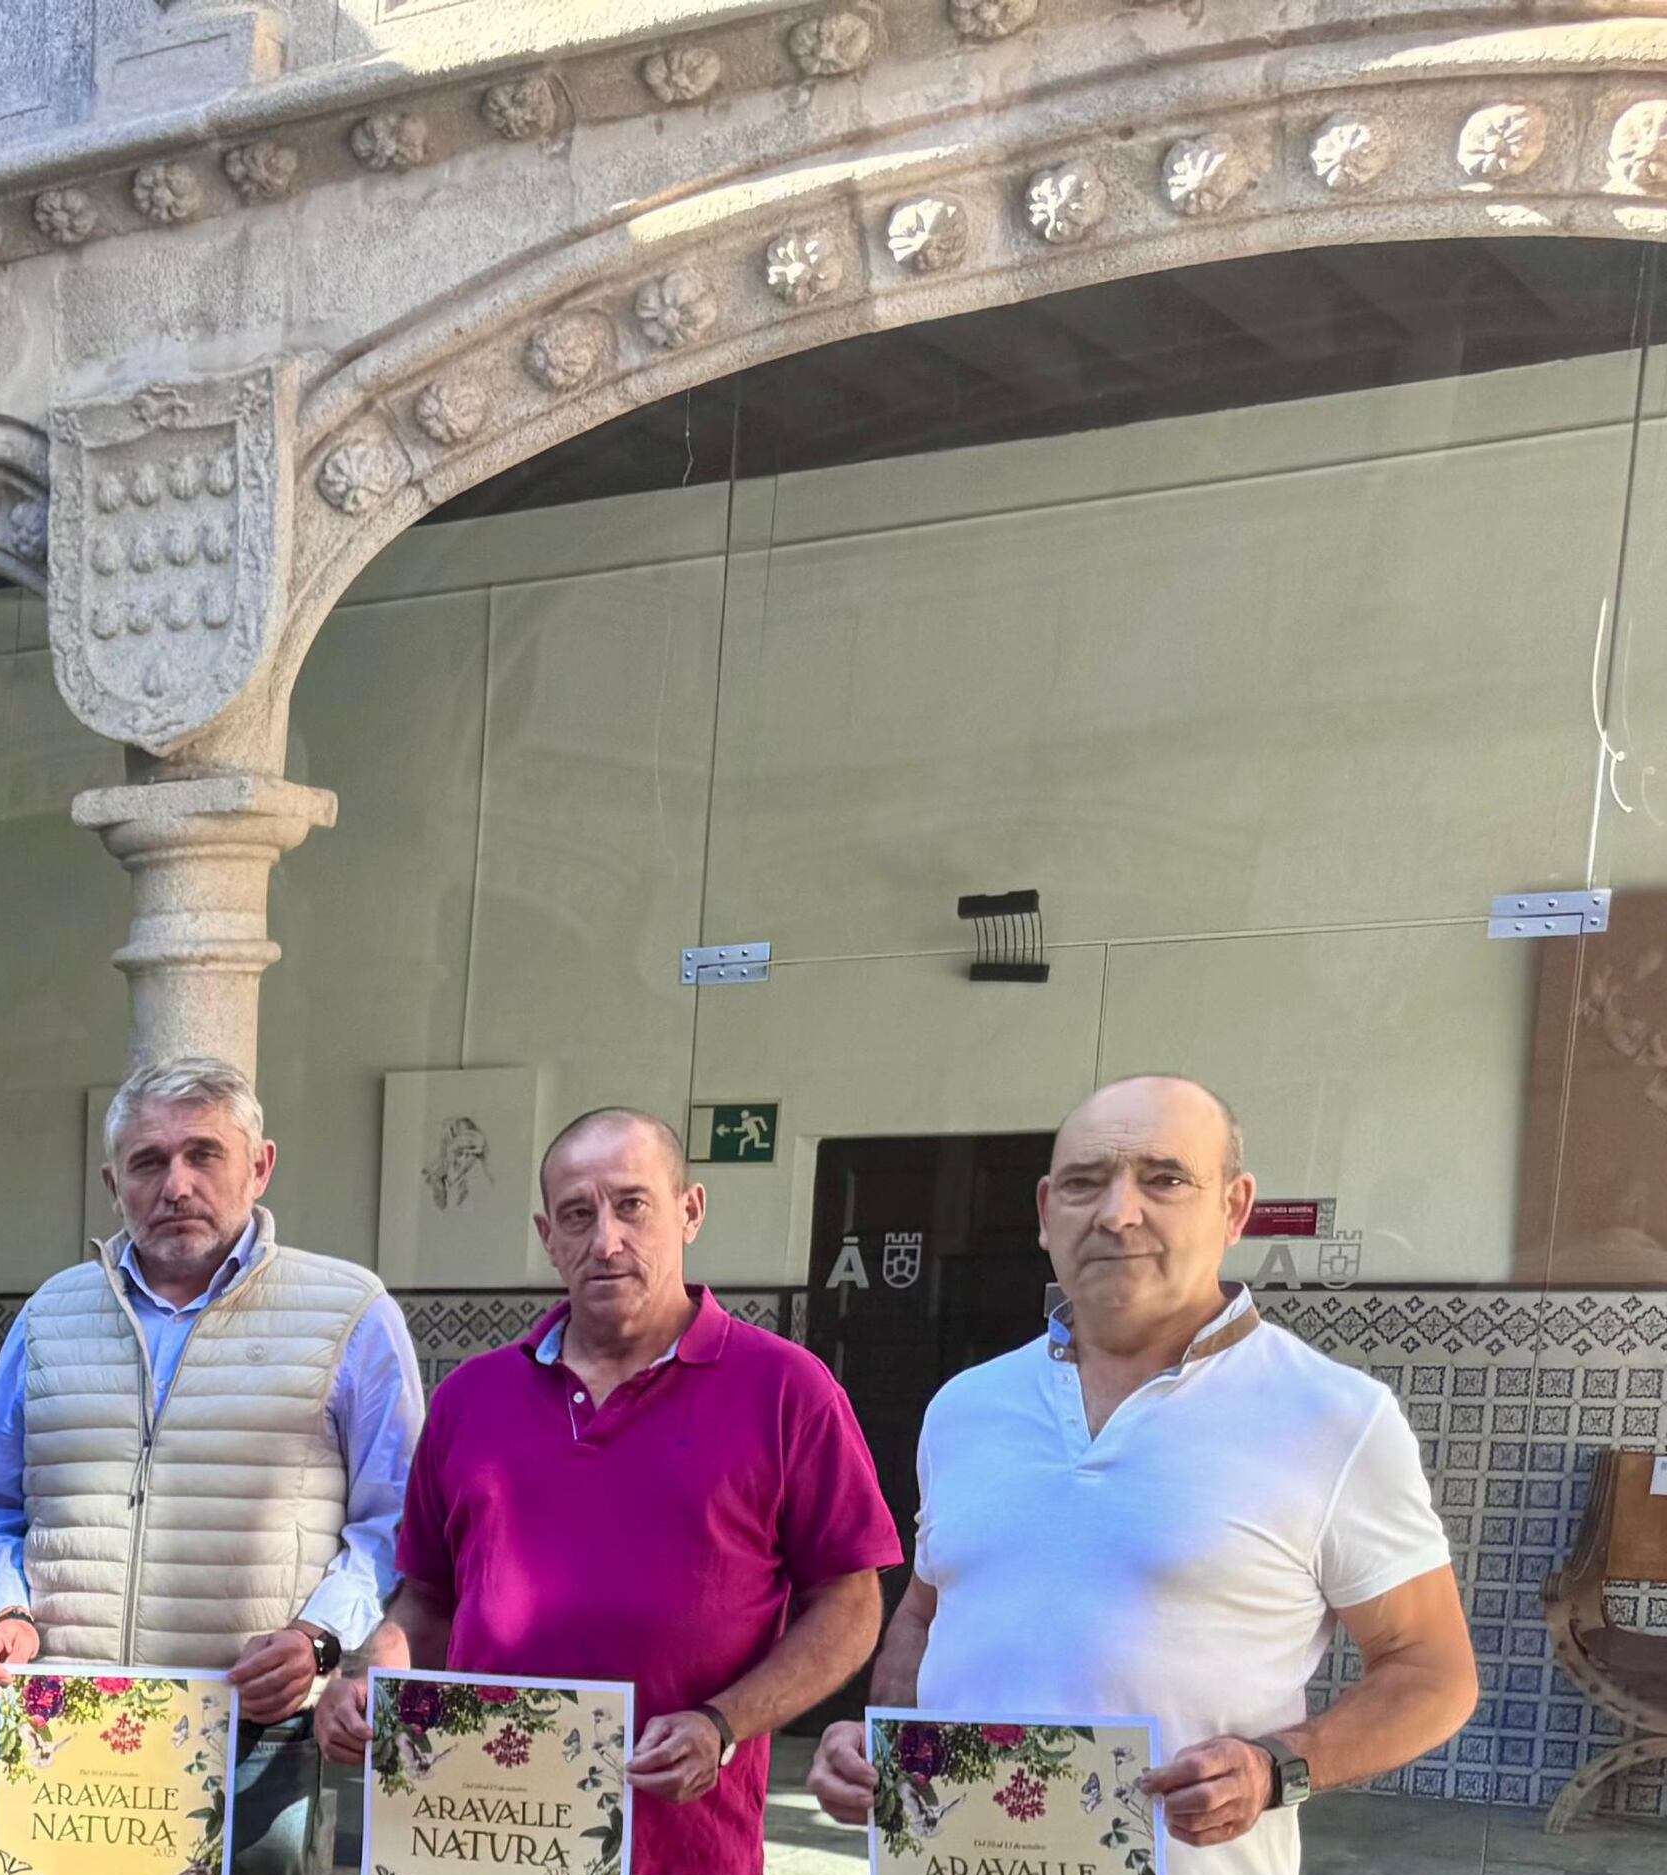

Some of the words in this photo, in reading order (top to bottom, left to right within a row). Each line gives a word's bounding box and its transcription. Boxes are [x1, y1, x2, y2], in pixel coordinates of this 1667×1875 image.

[32, 1782, 179, 1812] ARAVALLE
[411, 1795, 572, 1829] ARAVALLE
[31, 1812, 178, 1848] NATURA
[410, 1826, 570, 1868] NATURA
